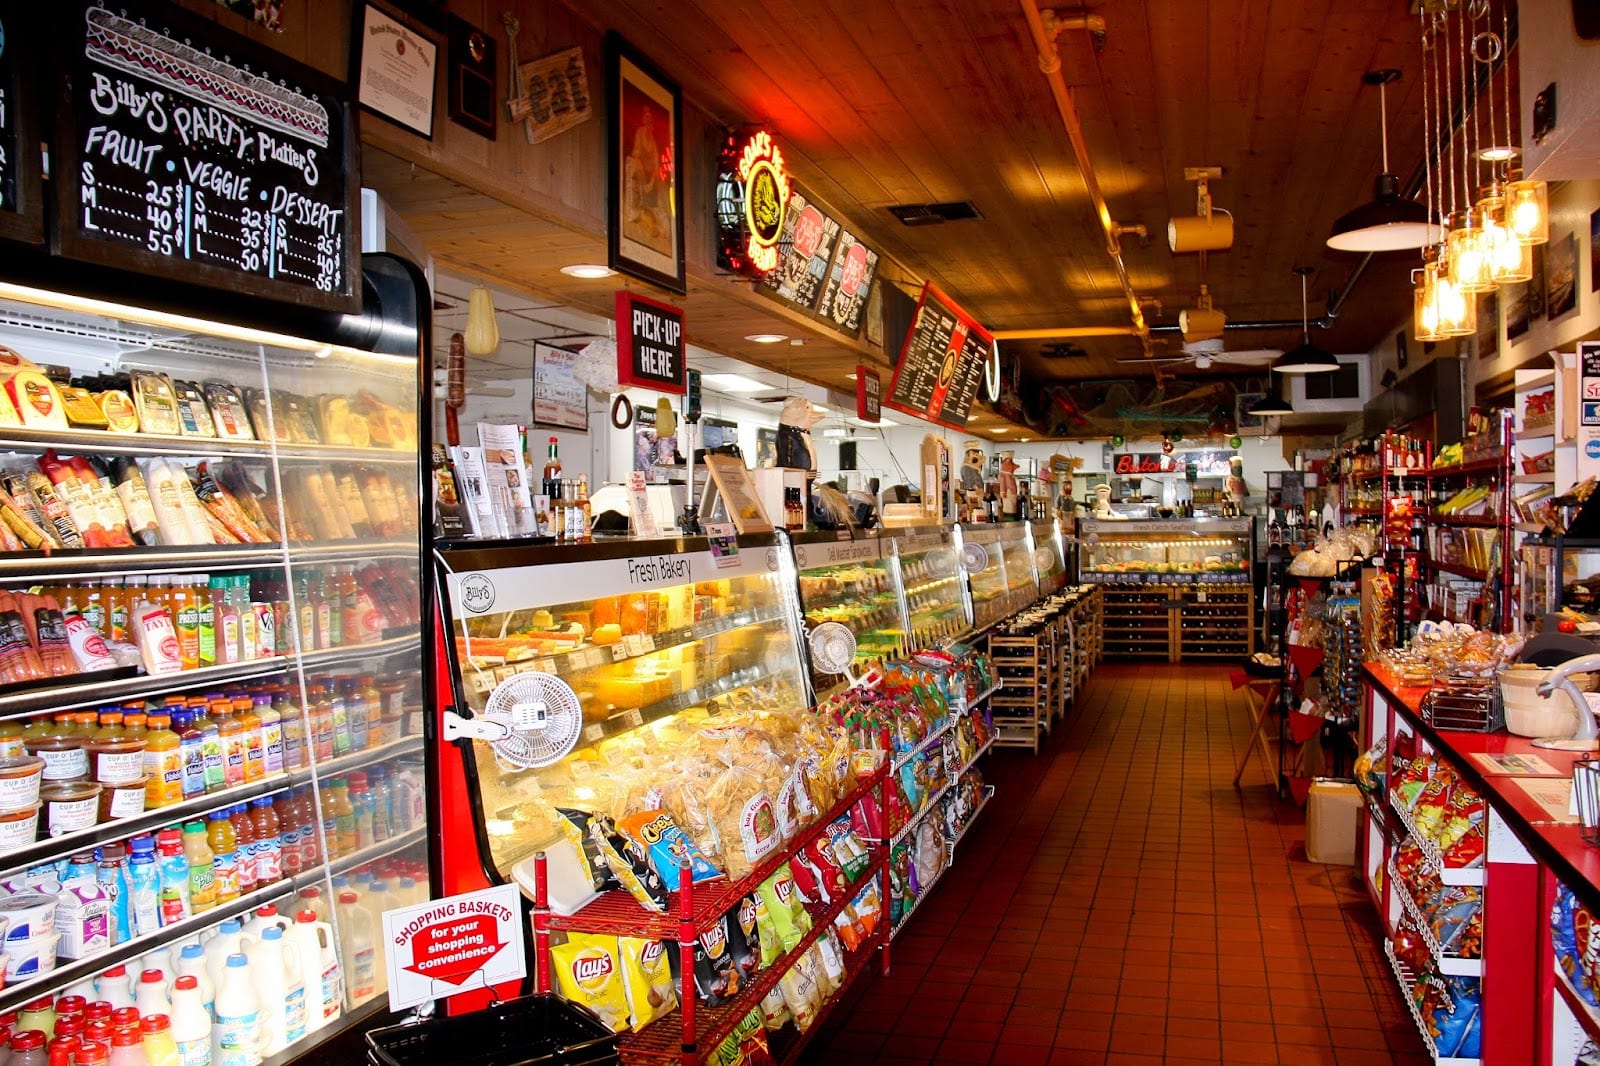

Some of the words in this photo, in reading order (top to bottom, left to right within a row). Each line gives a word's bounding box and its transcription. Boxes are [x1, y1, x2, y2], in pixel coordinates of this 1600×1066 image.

[173, 106, 254, 159] PARTY
[82, 161, 95, 185] S
[85, 125, 164, 174] FRUIT
[183, 157, 251, 201] VEGGIE
[270, 185, 344, 239] DESSERT
[81, 184, 97, 209] M
[194, 191, 206, 212] S
[84, 207, 100, 230] L
[194, 213, 208, 234] M
[277, 218, 287, 238] S
[196, 233, 208, 254] L
[276, 236, 288, 255] M
[278, 254, 288, 272] L
[632, 309, 681, 346] PICK-UP
[640, 346, 674, 378] HERE
[628, 554, 660, 584] Fresh
[659, 553, 692, 584] Bakery
[260, 612, 275, 631] V8
[395, 904, 455, 946] SHOPPING
[459, 901, 513, 922] BASKETS
[431, 928, 449, 939] for
[451, 921, 479, 935] your
[428, 934, 484, 954] shopping
[418, 945, 496, 970] convenience
